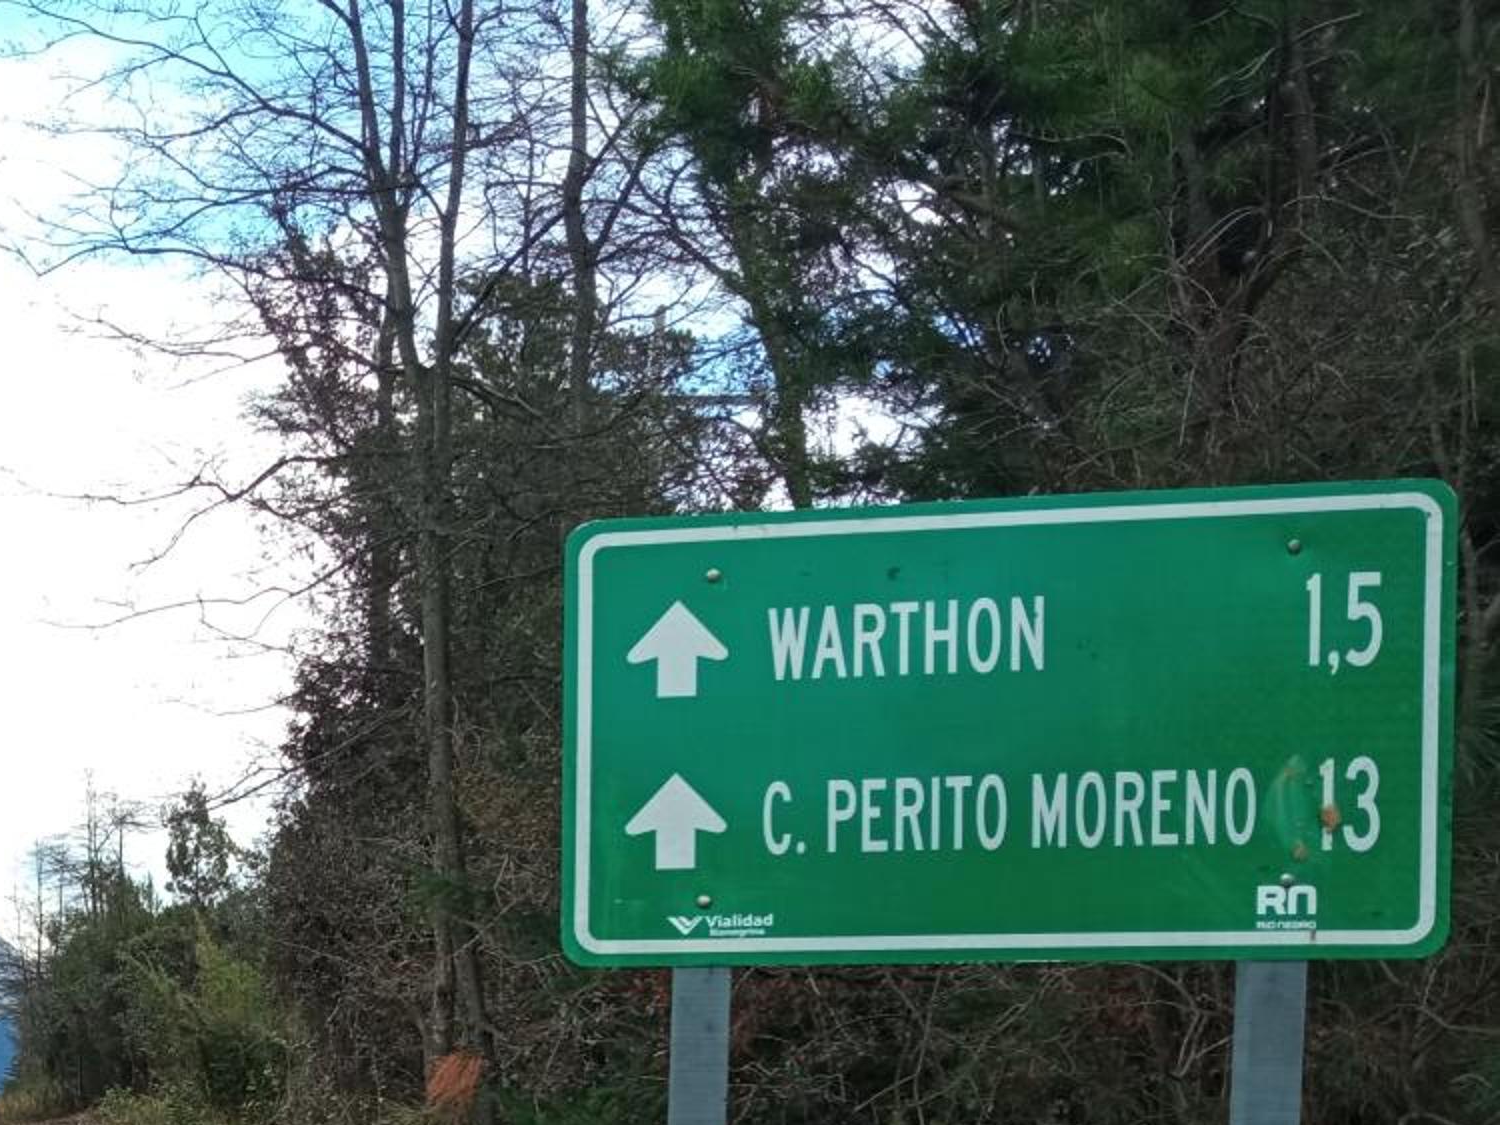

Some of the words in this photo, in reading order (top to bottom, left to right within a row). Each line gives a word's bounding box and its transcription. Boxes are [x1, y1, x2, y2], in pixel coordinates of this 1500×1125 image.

[767, 595, 1046, 681] WARTHON
[1305, 570, 1384, 676] 1,5
[763, 780, 807, 857] C.
[827, 773, 1008, 854] PERITO
[1031, 766, 1257, 849] MORENO
[1318, 755, 1381, 853] 13
[705, 912, 774, 928] Vialidad
